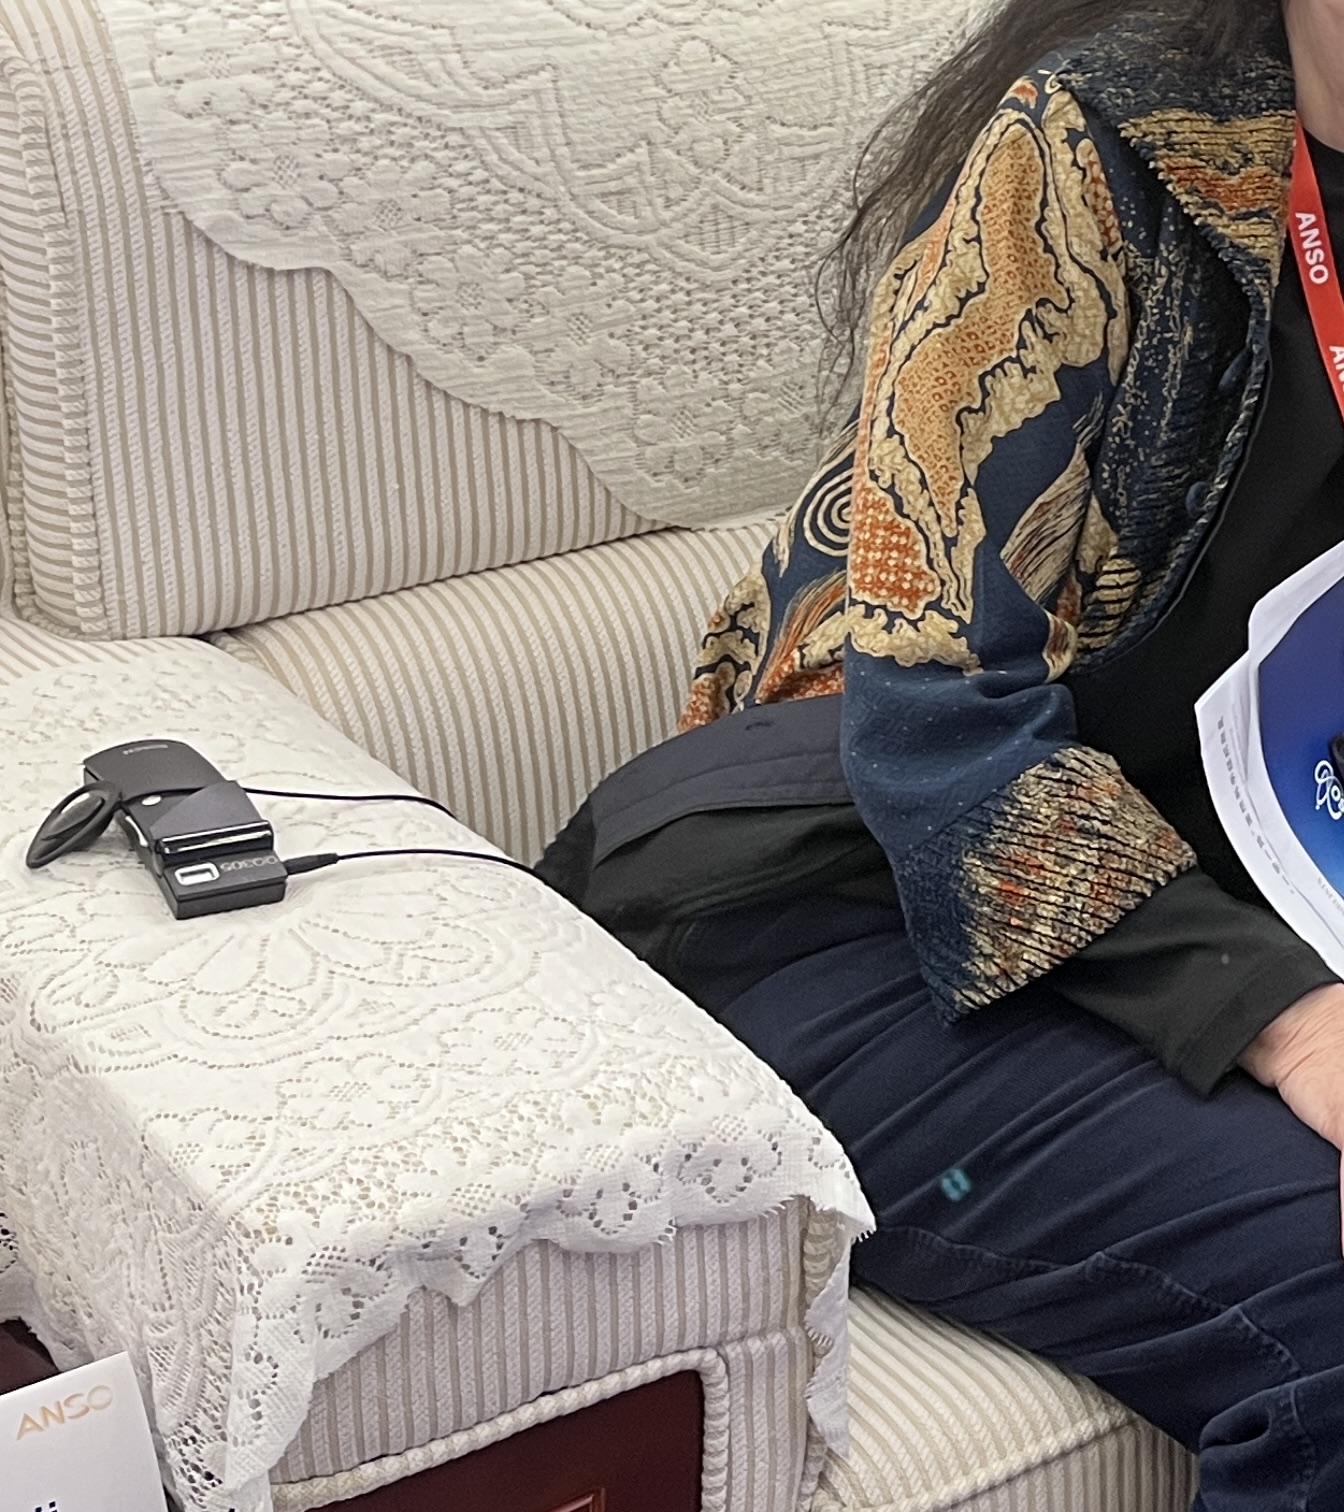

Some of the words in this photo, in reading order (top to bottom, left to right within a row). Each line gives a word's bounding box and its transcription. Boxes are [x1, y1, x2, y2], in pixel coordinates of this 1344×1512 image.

[1296, 212, 1329, 285] ANSO
[220, 855, 278, 871] 00305
[16, 1384, 114, 1441] ANSO
